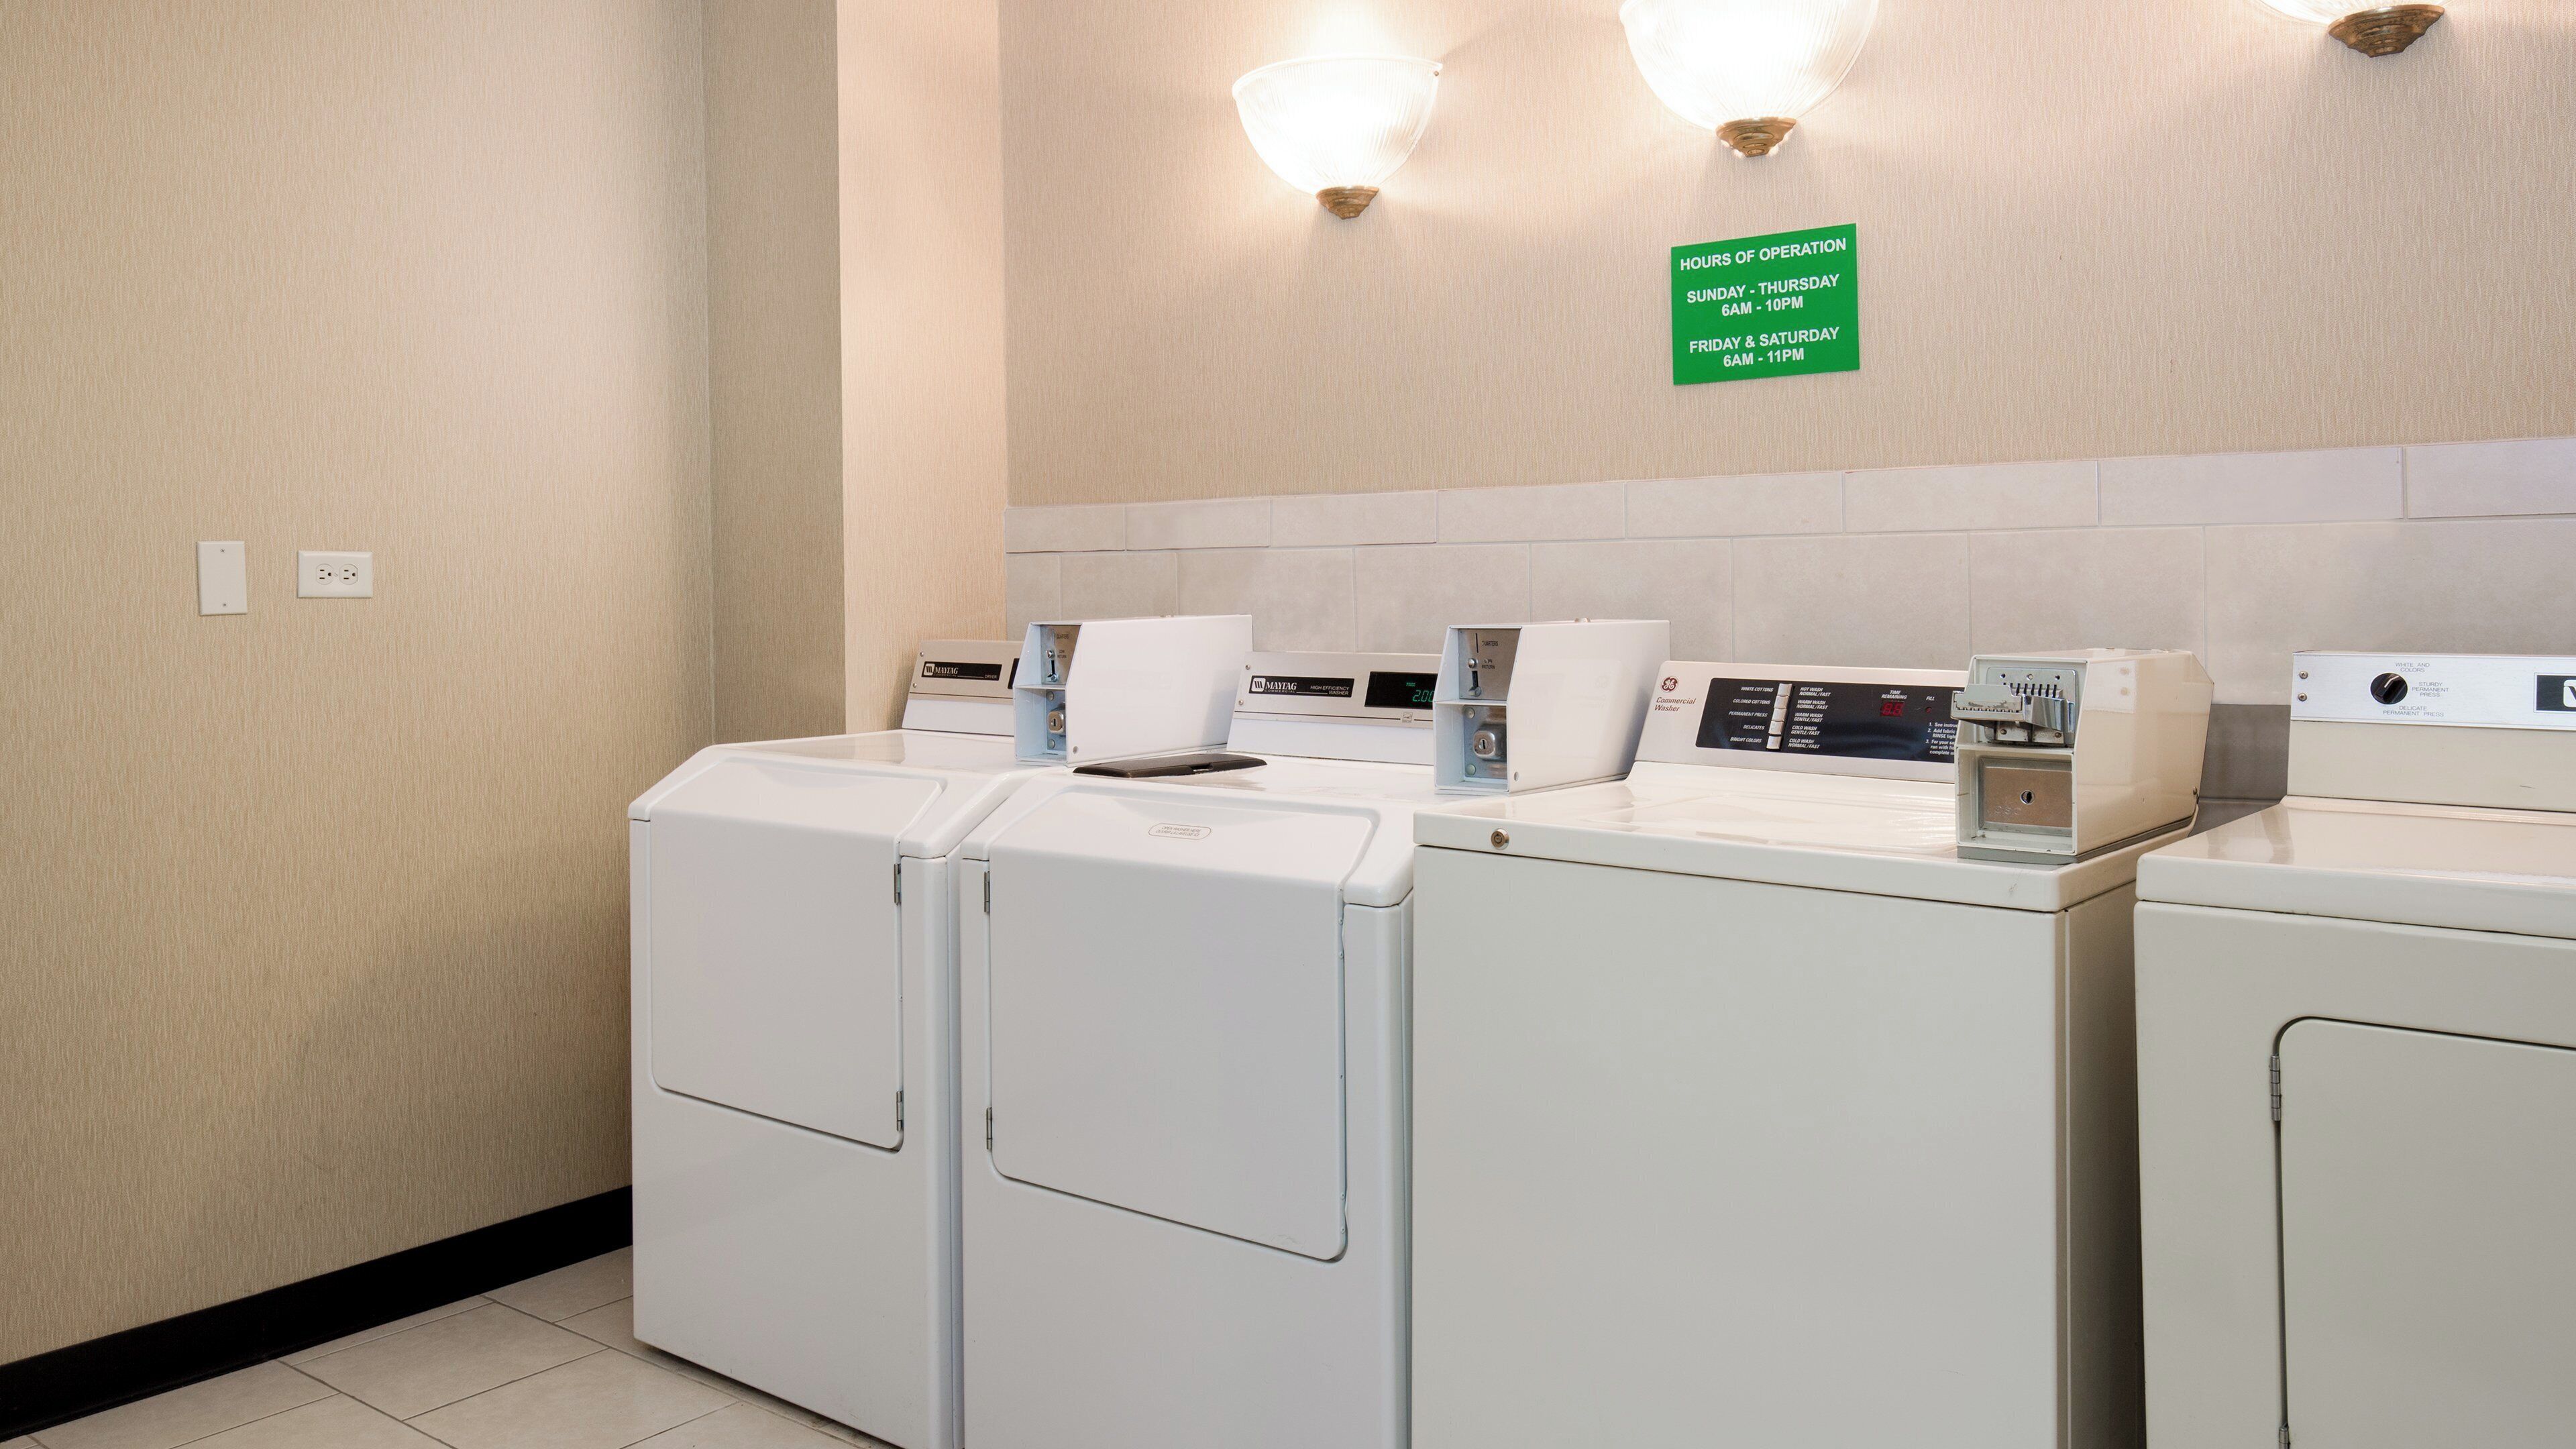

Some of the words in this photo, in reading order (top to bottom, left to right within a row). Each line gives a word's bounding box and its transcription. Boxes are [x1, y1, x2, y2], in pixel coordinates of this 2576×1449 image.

[1680, 254, 1731, 270] HOURS
[1735, 250, 1755, 264] OF
[1759, 238, 1846, 261] OPERATION
[1687, 285, 1746, 303] SUNDAY
[1758, 274, 1839, 294] THURSDAY
[1722, 302, 1752, 316] 6AM
[1766, 296, 1803, 311] 10PM
[1690, 337, 1741, 353] FRIDAY
[1745, 336, 1755, 348] &
[1760, 327, 1839, 346] SATURDAY
[1723, 353, 1753, 367] 6AM
[1767, 348, 1804, 363] 11PM
[1265, 682, 1297, 690] MAYTAG
[1656, 696, 1697, 704] Commercial
